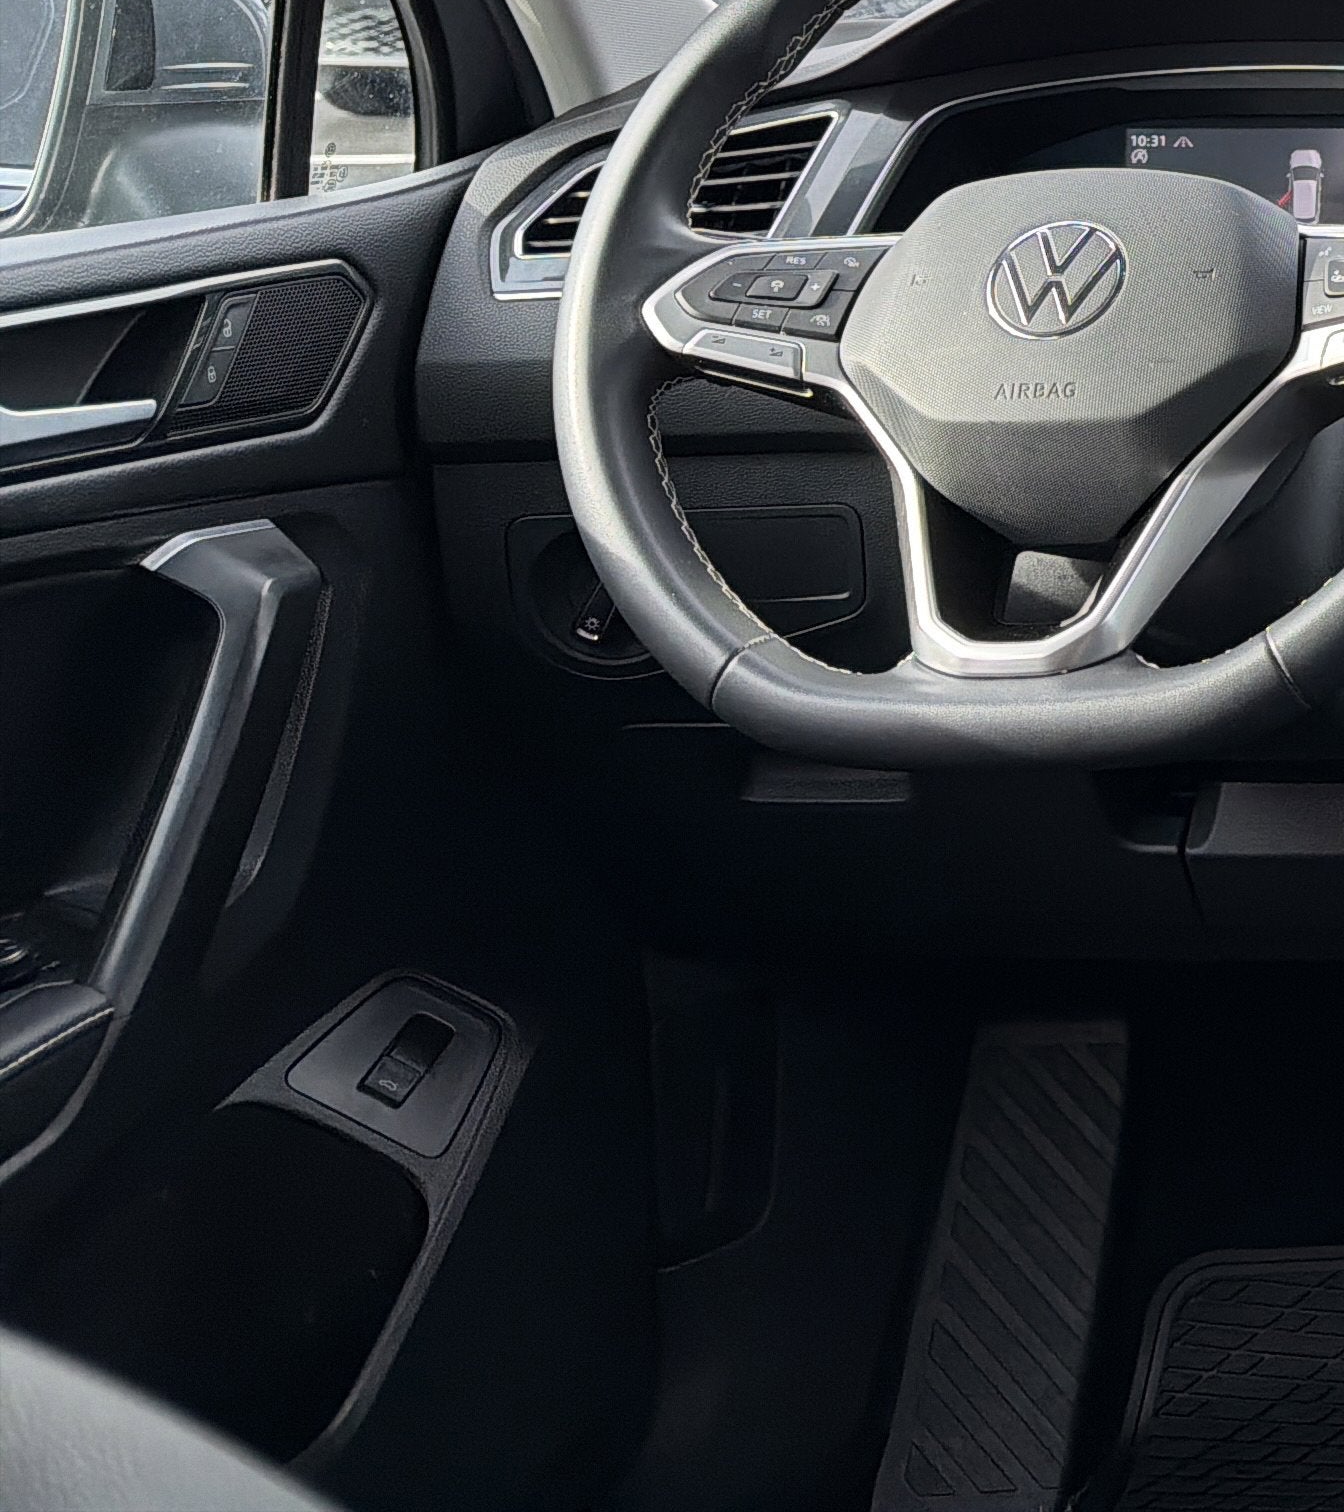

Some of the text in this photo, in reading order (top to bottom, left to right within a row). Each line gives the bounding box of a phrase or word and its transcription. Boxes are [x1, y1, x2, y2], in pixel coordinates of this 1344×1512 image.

[1129, 134, 1167, 148] 10:31
[785, 256, 807, 266] RES
[987, 220, 1128, 339] VW
[751, 309, 772, 319] SET
[1311, 303, 1333, 316] VIEW
[993, 381, 1079, 401] AIRBAG
